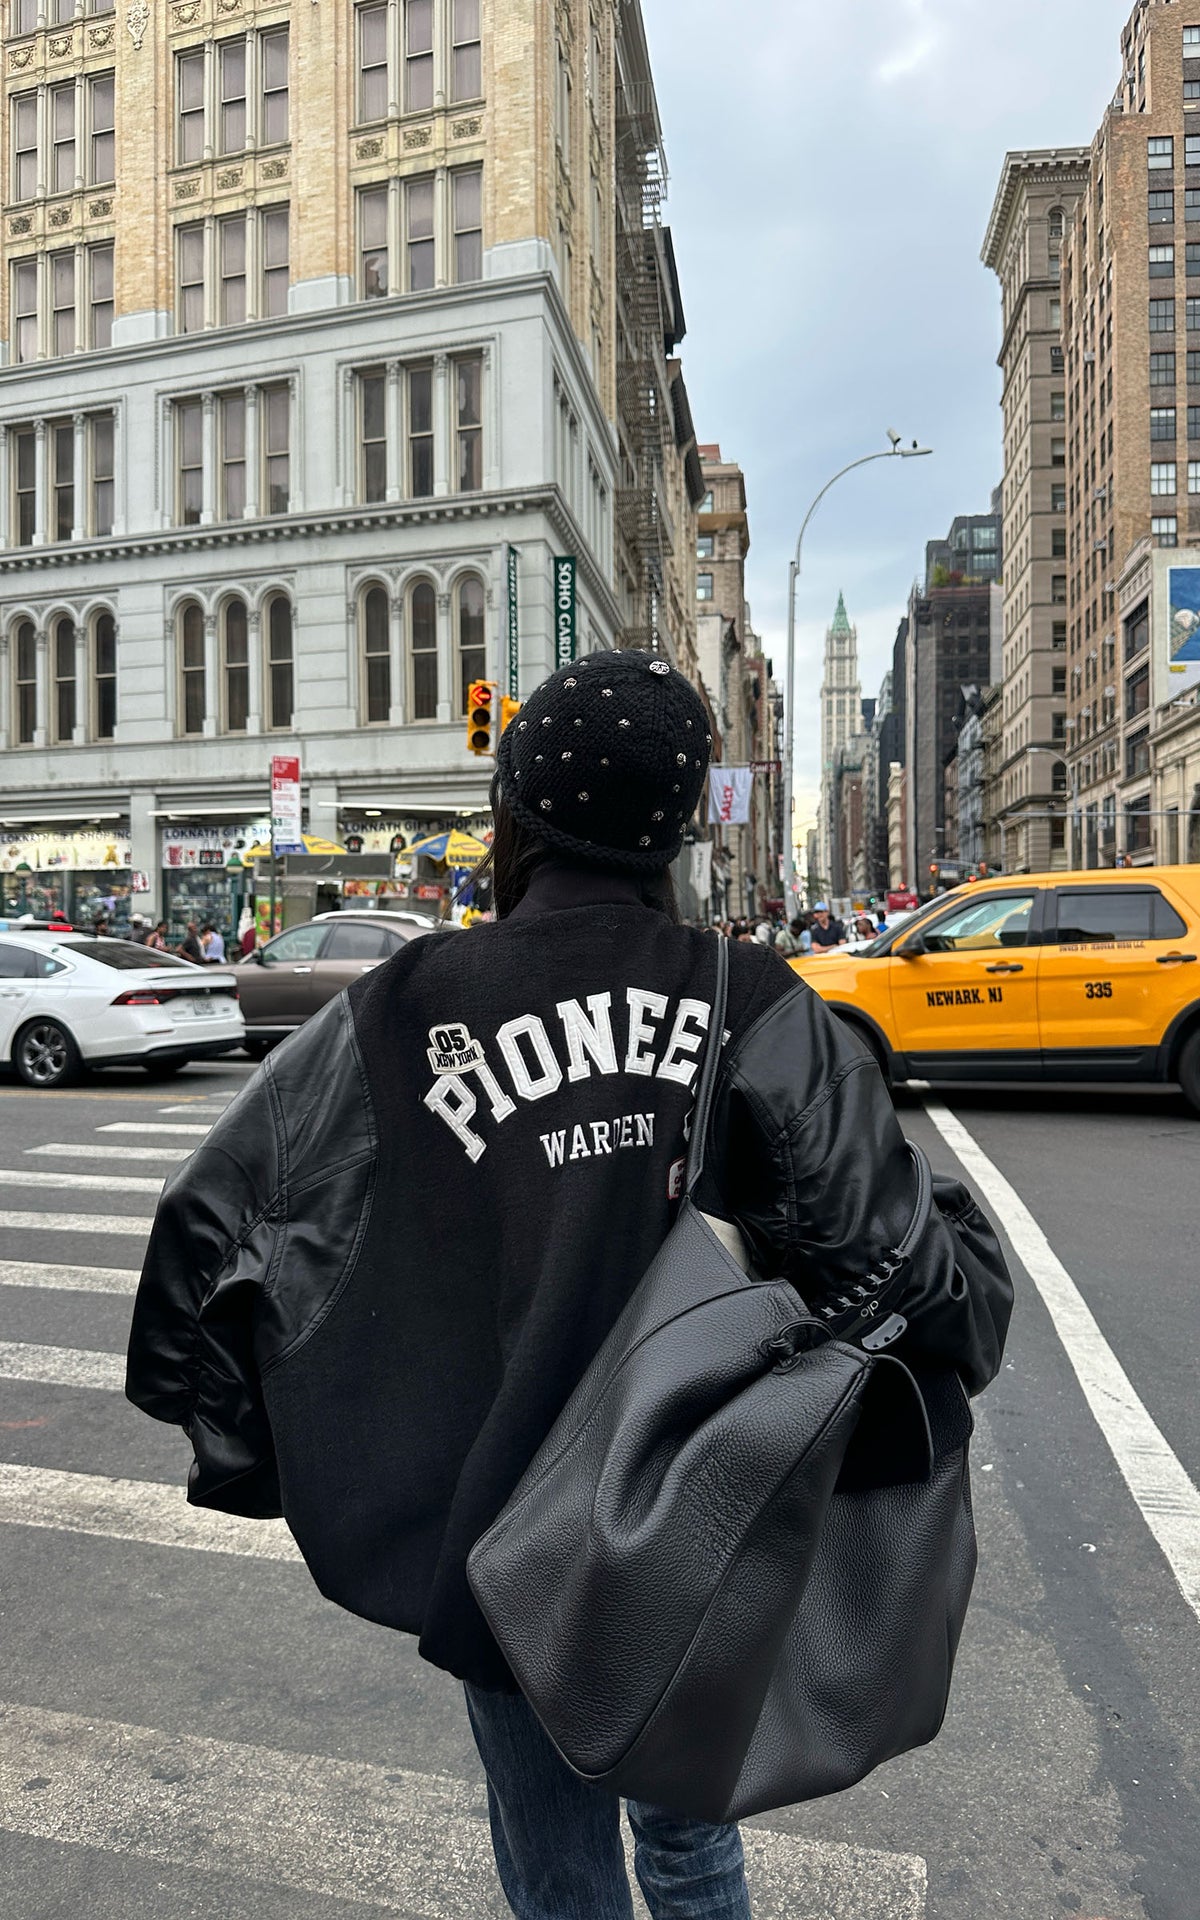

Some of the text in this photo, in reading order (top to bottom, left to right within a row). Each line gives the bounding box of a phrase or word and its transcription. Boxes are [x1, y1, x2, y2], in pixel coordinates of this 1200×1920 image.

[558, 562, 572, 668] SOHO GARDE
[165, 827, 218, 839] LOKNATH
[223, 826, 247, 837] GIFT
[344, 821, 400, 833] LOKNATH
[404, 820, 431, 831] GIFT
[438, 819, 472, 831] SHOP
[988, 987, 1003, 1003] NJ
[1085, 982, 1113, 999] 335
[435, 1029, 466, 1053] 05
[434, 1045, 479, 1068] NEW YORK
[423, 986, 731, 1163] PIONEE
